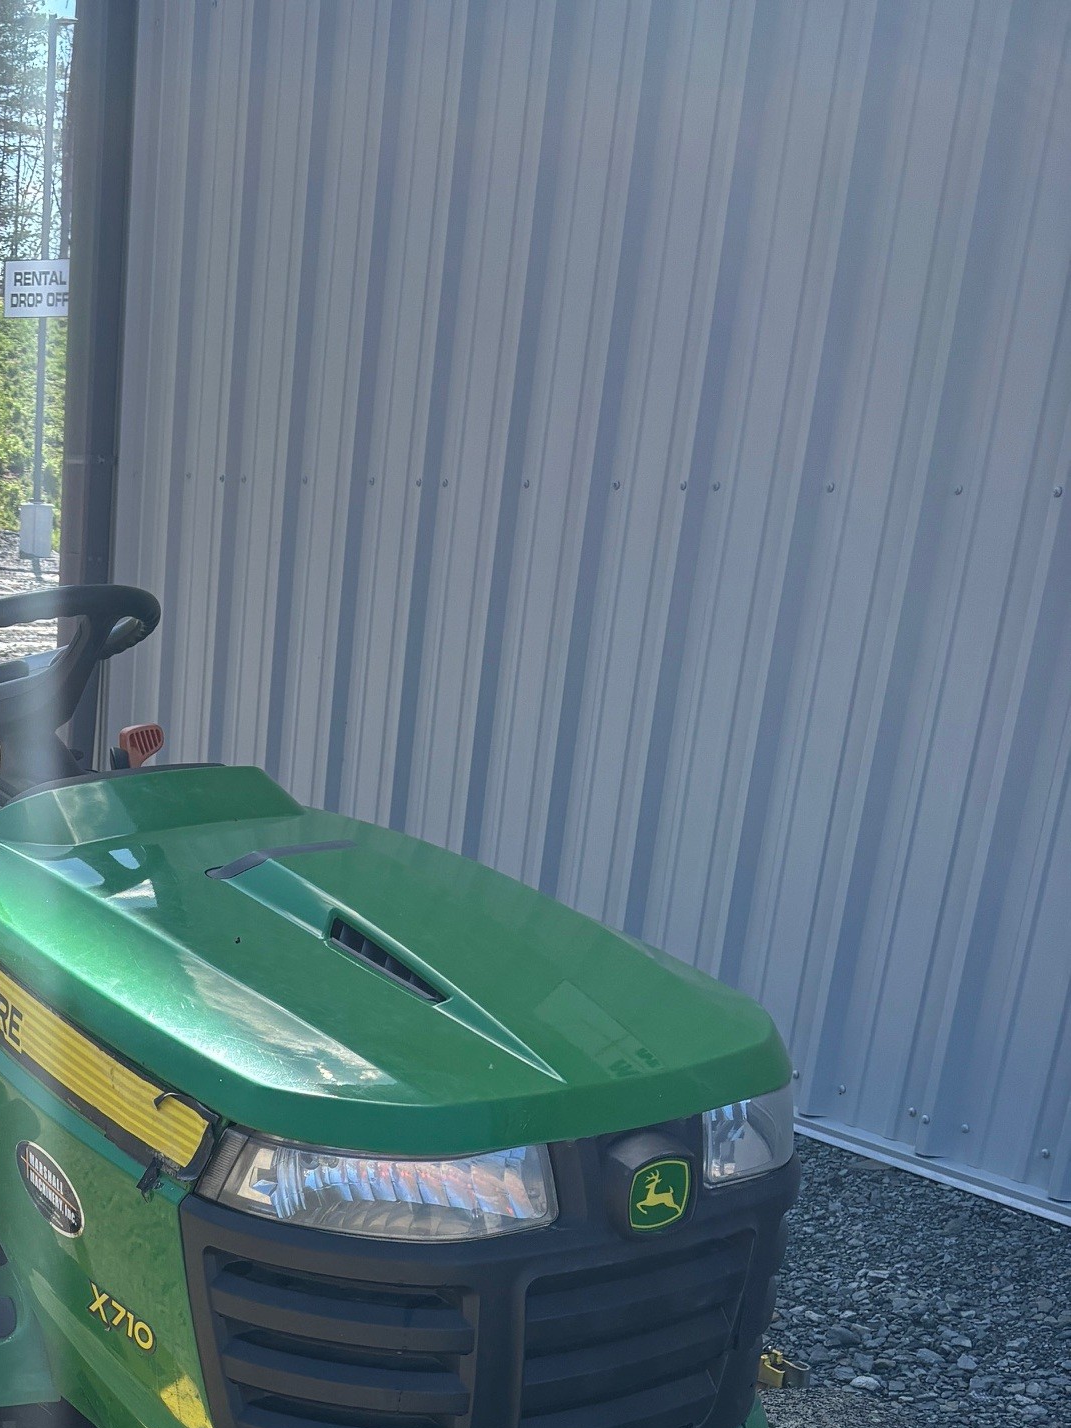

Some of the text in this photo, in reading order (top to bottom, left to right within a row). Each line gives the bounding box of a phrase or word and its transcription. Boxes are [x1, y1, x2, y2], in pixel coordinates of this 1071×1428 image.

[13, 270, 67, 287] RENTAL
[10, 292, 69, 308] DROP OFF
[29, 1151, 64, 1195] MARSHALL
[88, 1281, 155, 1351] X710
